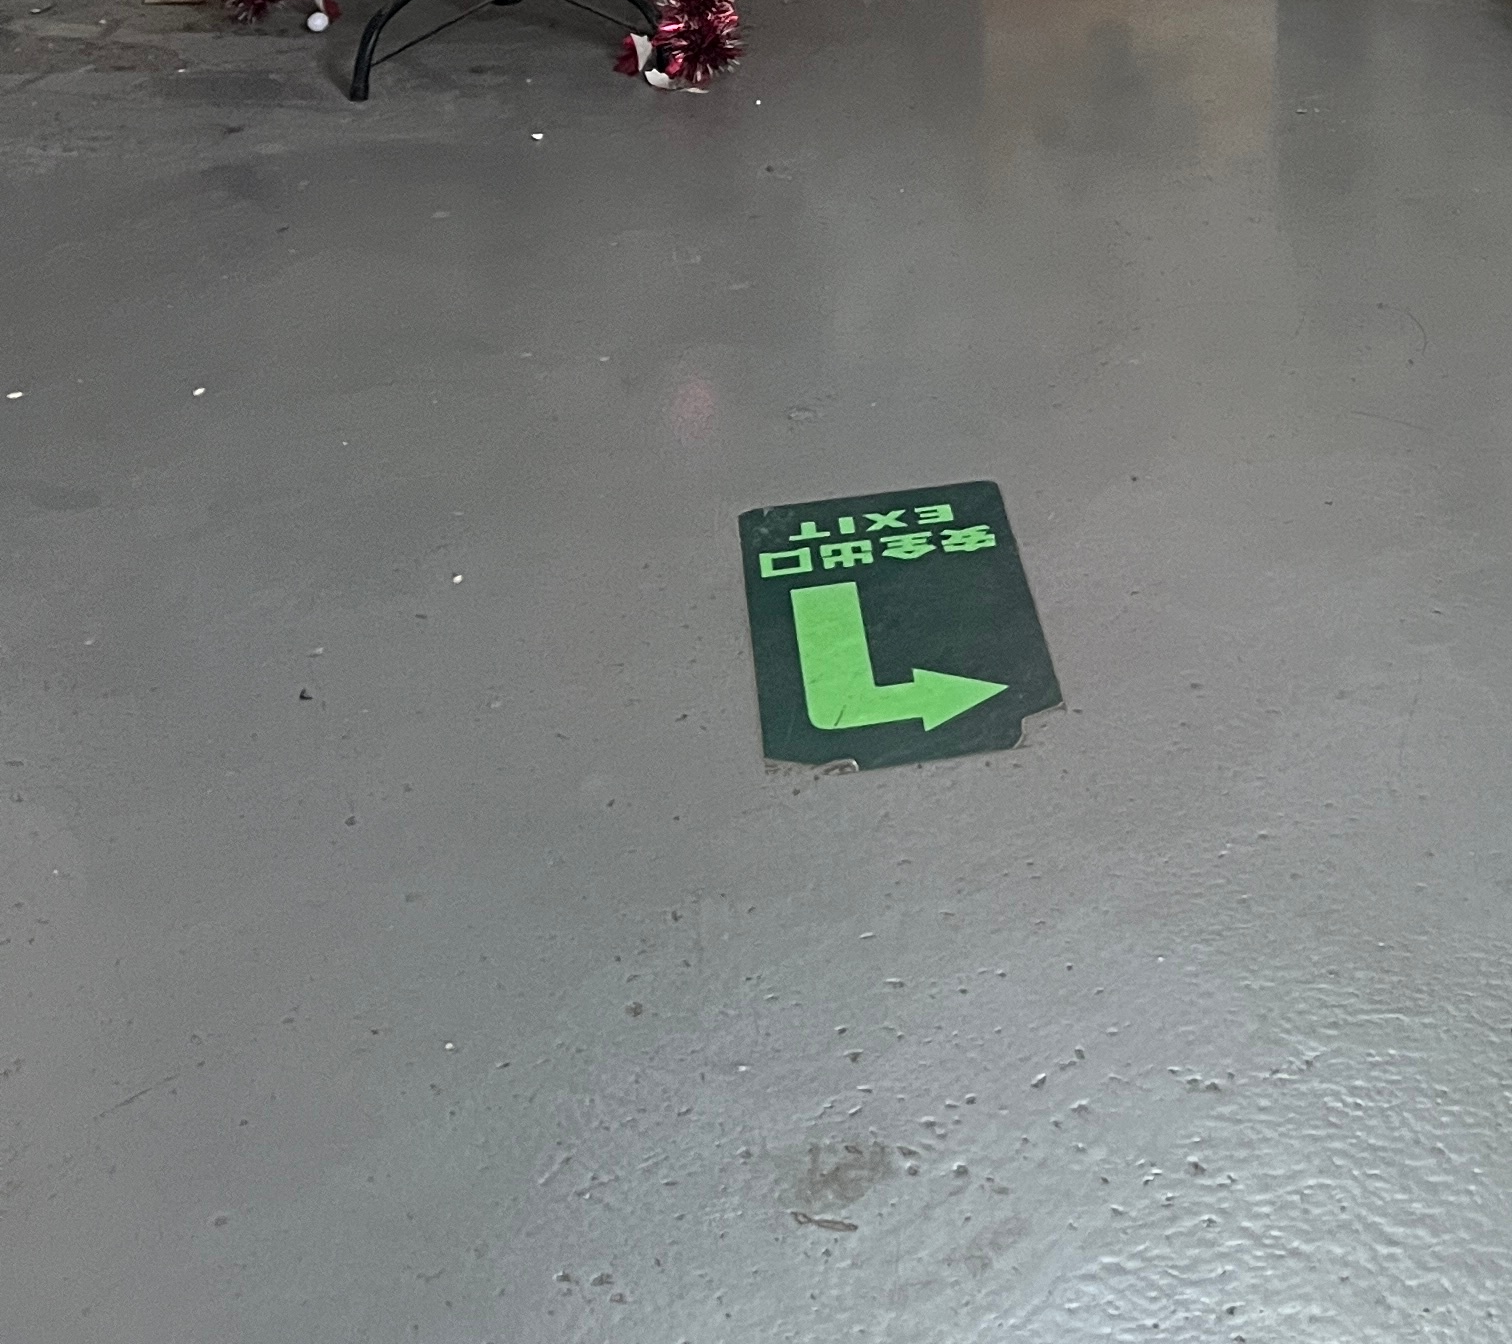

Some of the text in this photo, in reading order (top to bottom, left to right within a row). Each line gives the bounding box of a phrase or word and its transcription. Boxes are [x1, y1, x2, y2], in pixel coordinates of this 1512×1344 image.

[789, 503, 955, 542] EXIT
[758, 525, 997, 579] 安全出口
